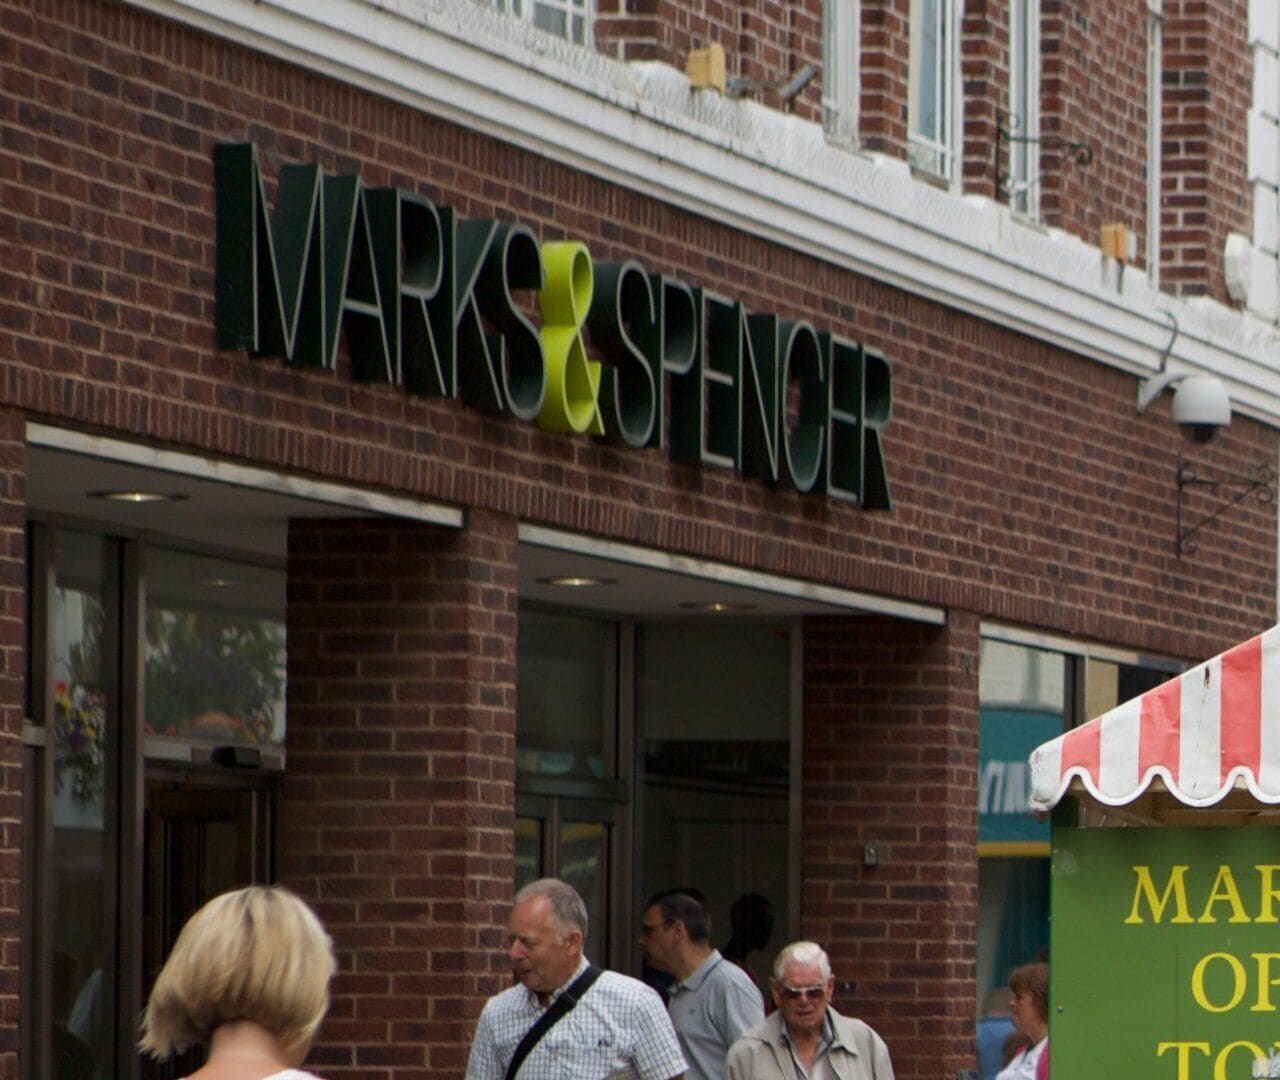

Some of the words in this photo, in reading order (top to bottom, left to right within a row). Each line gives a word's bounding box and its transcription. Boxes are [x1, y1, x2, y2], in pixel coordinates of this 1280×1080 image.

[216, 142, 546, 420] MARKS
[537, 240, 605, 436] &
[594, 260, 892, 511] SPENCER
